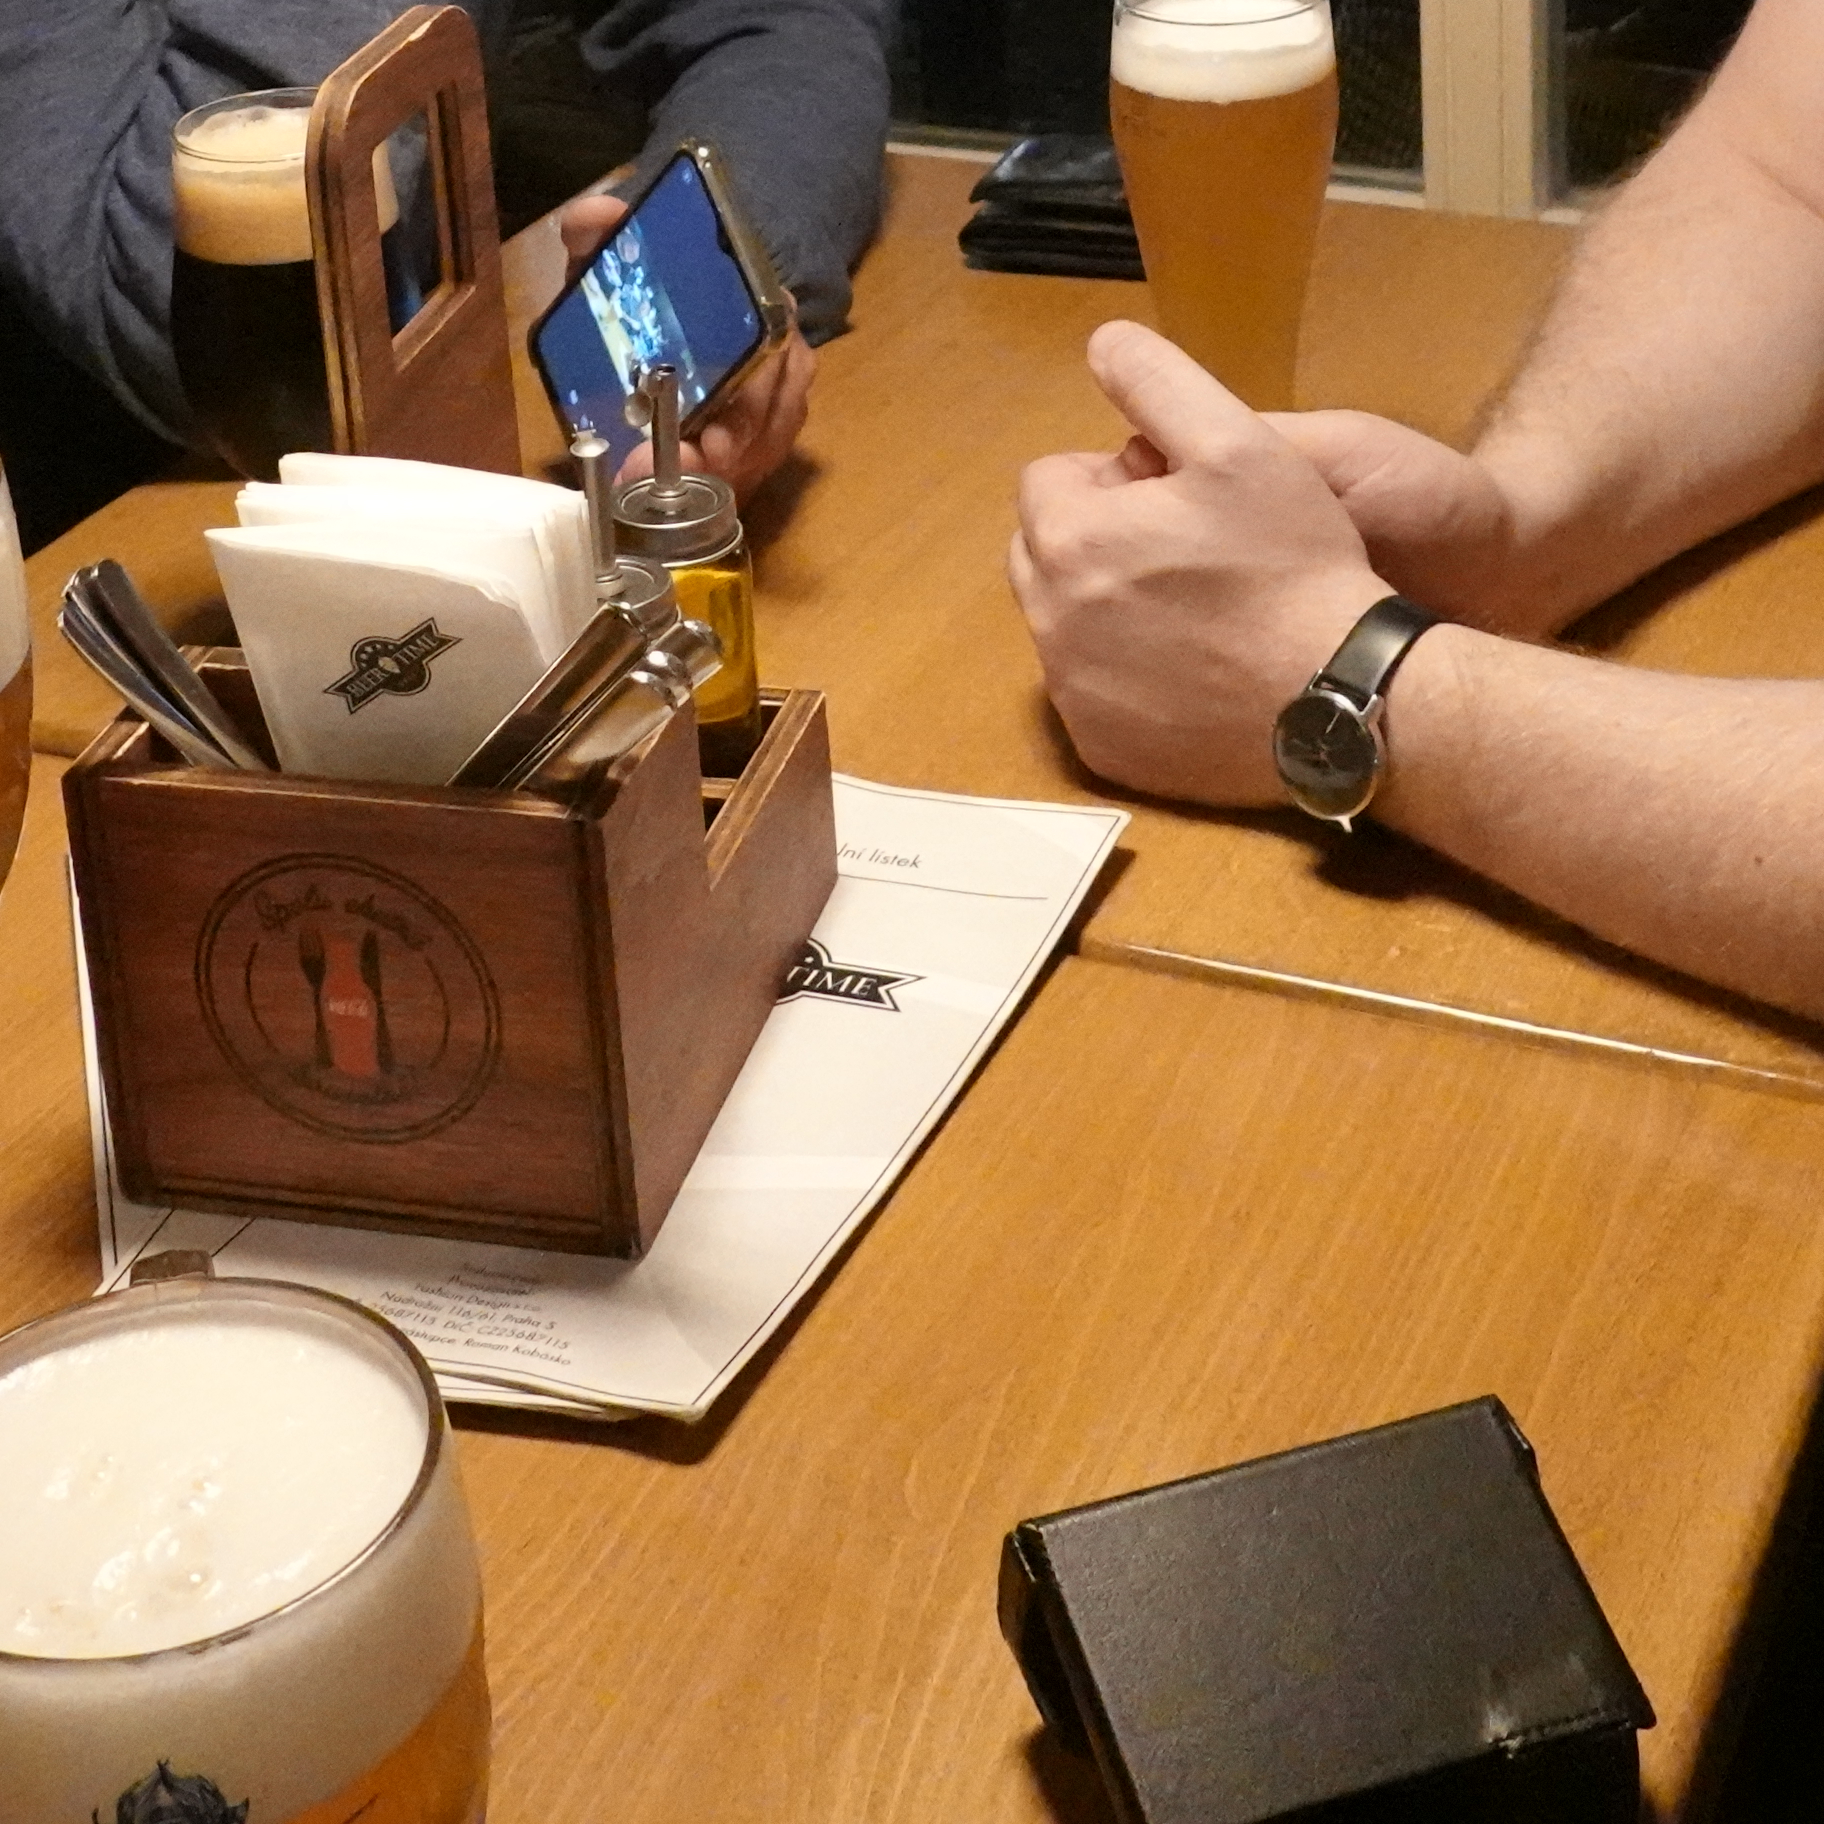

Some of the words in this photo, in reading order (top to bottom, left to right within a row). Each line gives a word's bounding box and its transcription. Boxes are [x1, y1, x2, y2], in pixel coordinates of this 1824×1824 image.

[836, 842, 867, 861] lní
[870, 848, 923, 870] lístek
[787, 965, 878, 997] TIME
